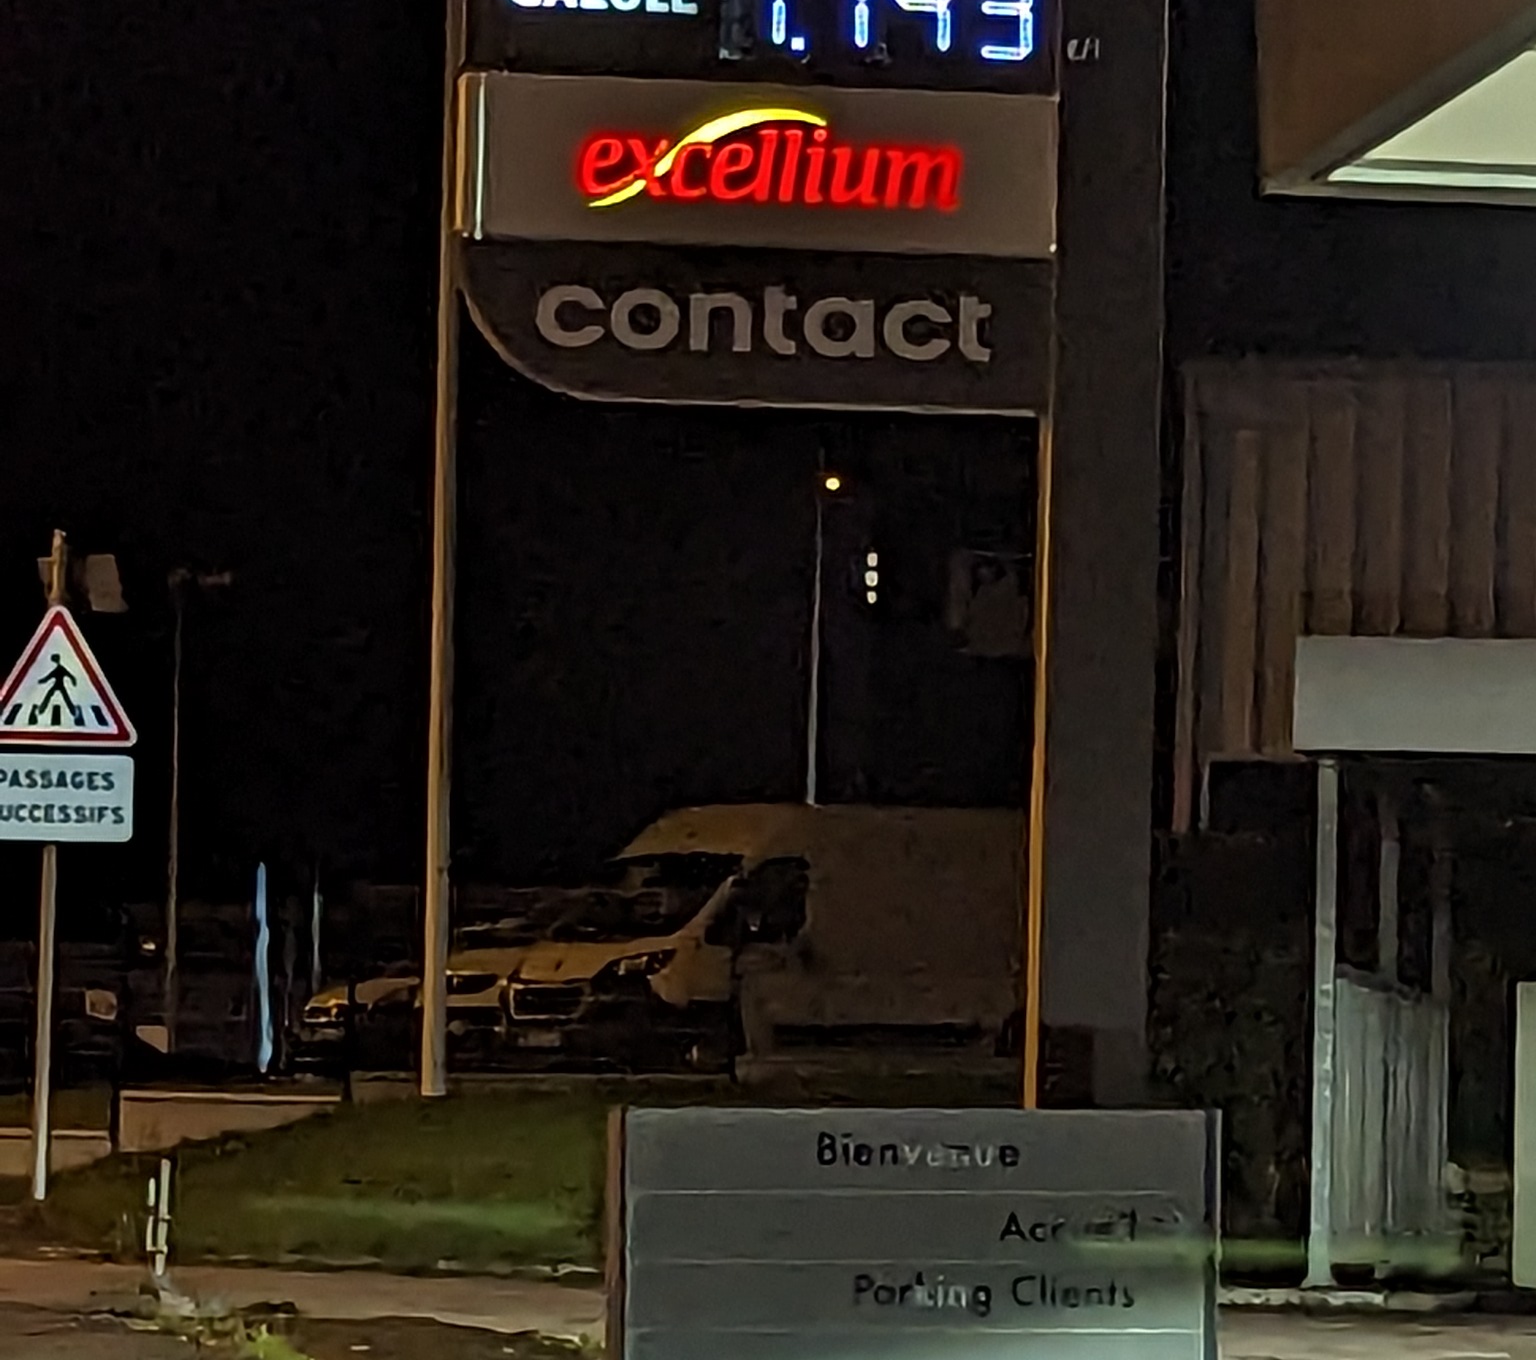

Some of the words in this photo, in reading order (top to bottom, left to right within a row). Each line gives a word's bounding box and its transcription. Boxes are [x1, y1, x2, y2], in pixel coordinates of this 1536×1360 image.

[579, 126, 962, 212] excellium
[535, 283, 992, 362] contact
[0, 768, 115, 792] PASSAGES
